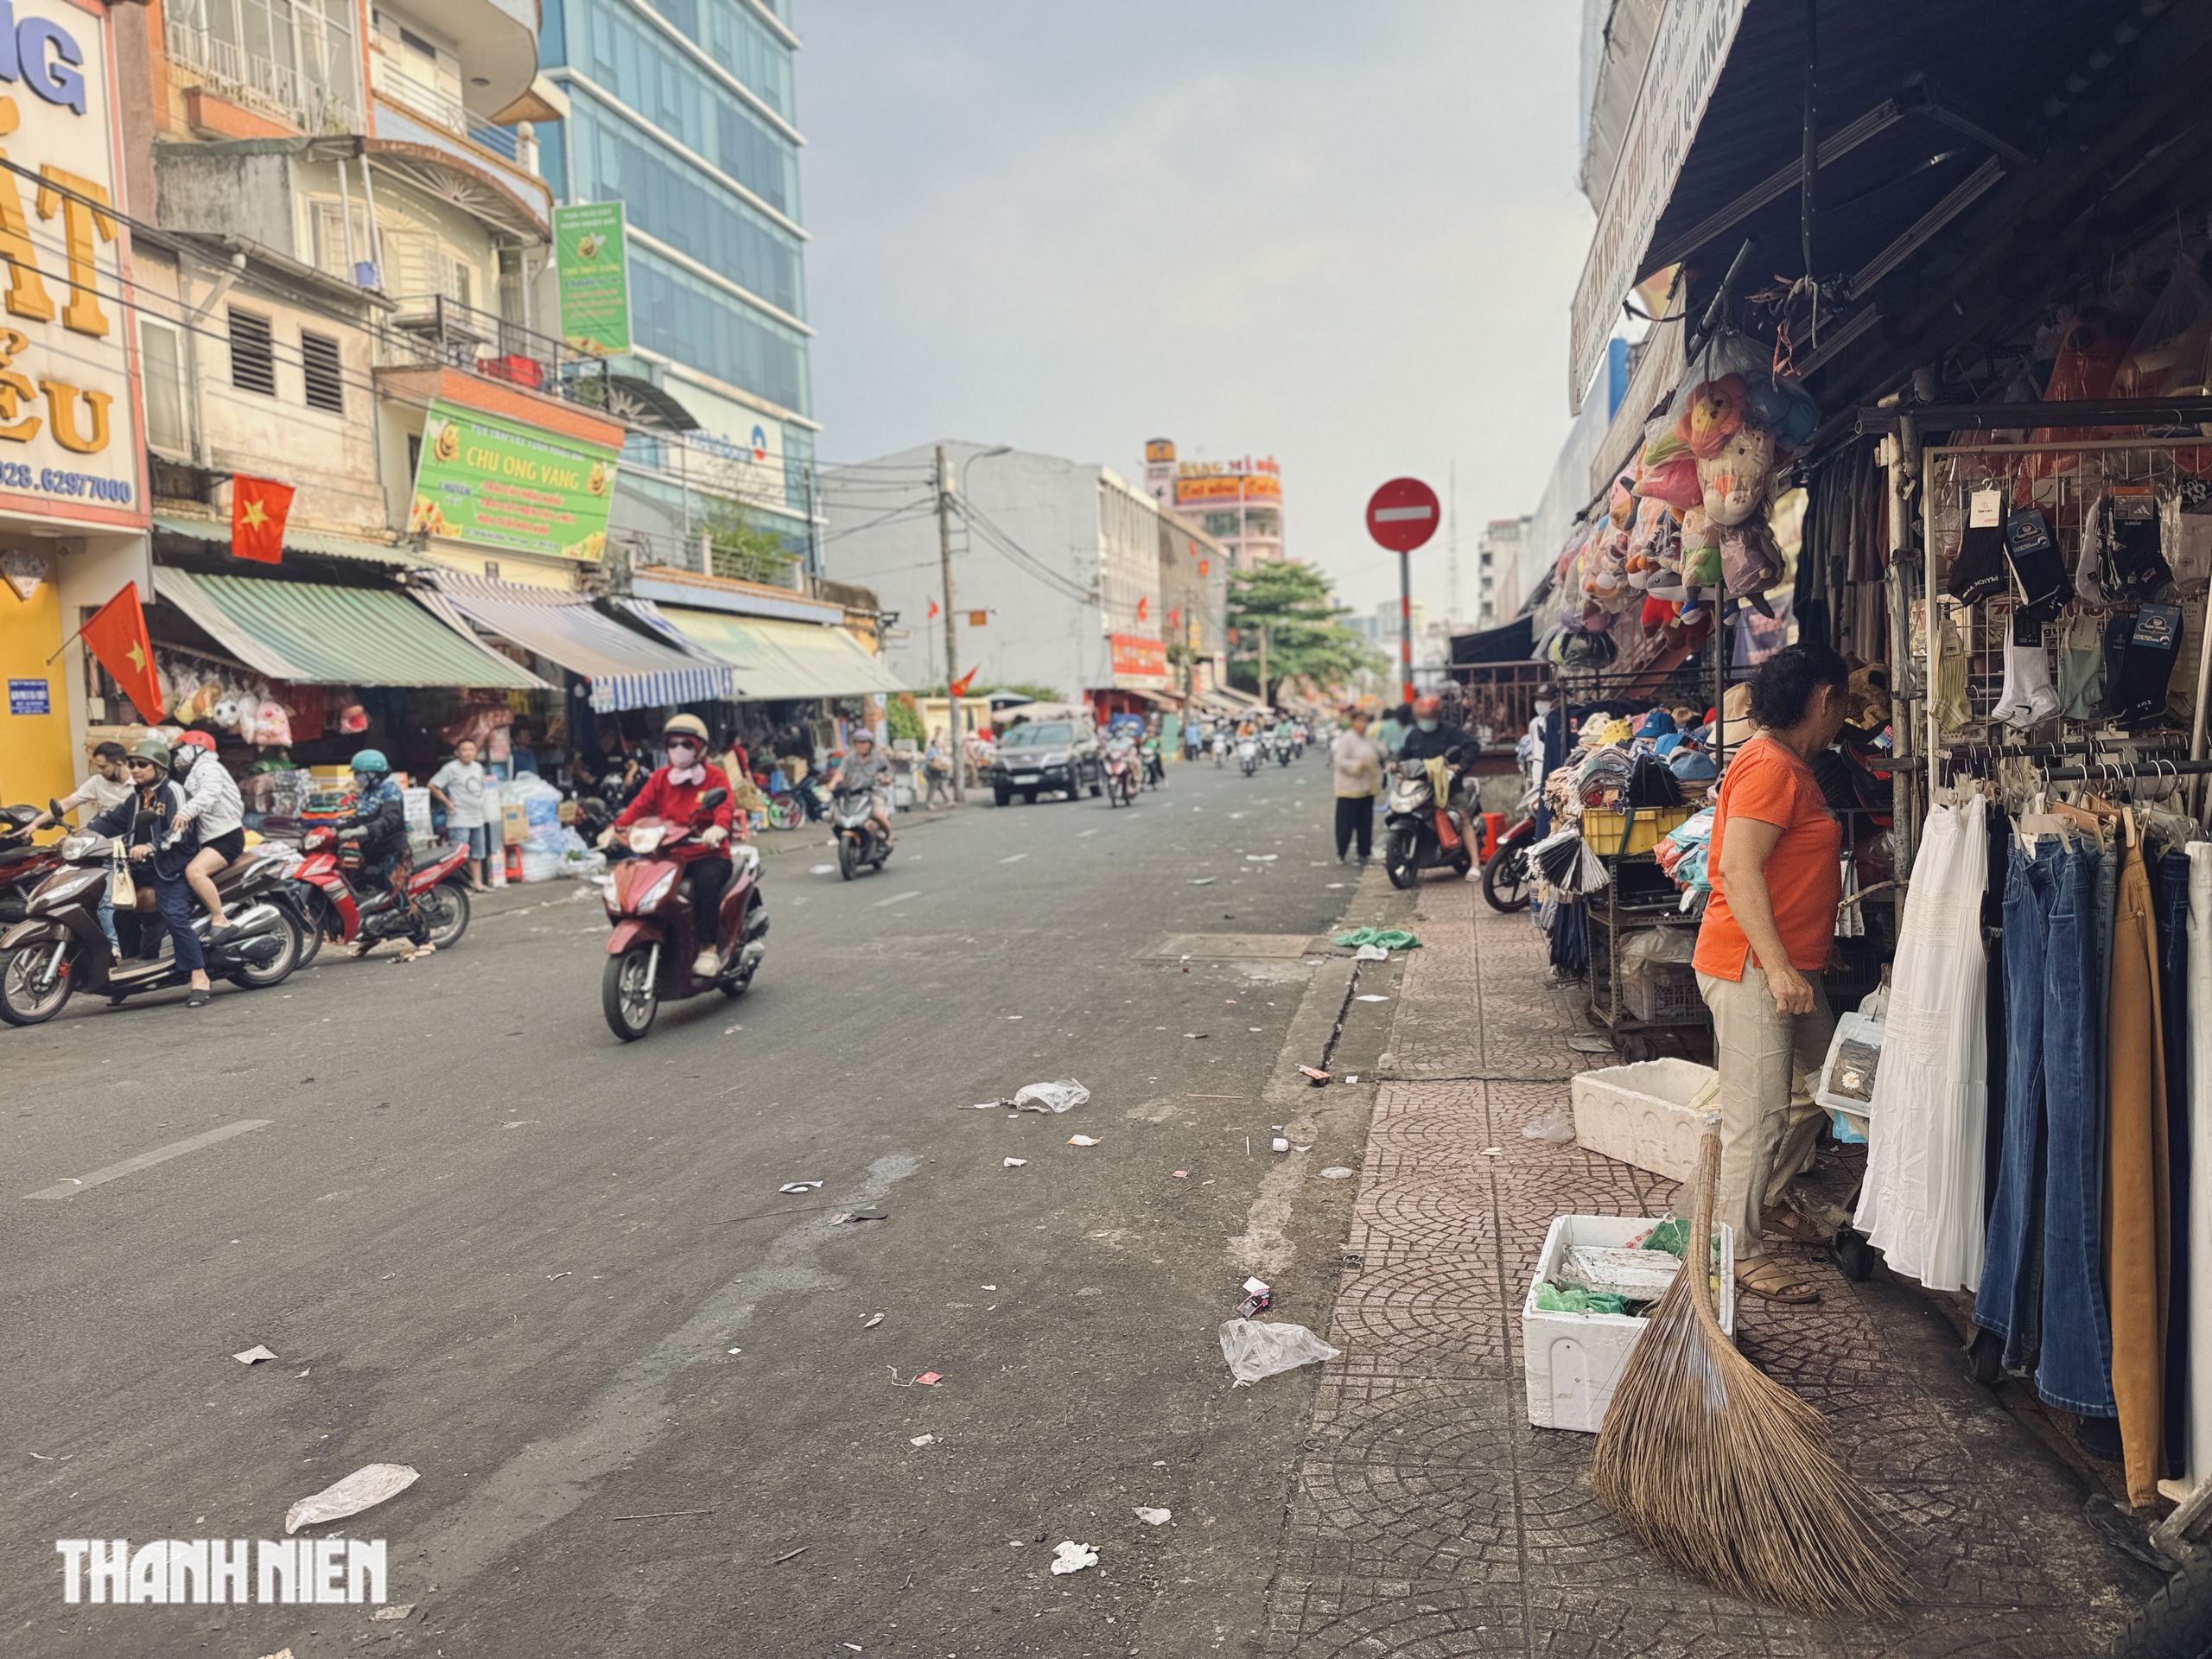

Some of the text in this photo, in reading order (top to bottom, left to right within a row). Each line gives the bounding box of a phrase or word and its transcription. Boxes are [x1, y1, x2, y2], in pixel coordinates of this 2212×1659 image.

[0, 0, 86, 116] G
[1684, 0, 1727, 132] QUANG
[503, 454, 537, 481] ONG
